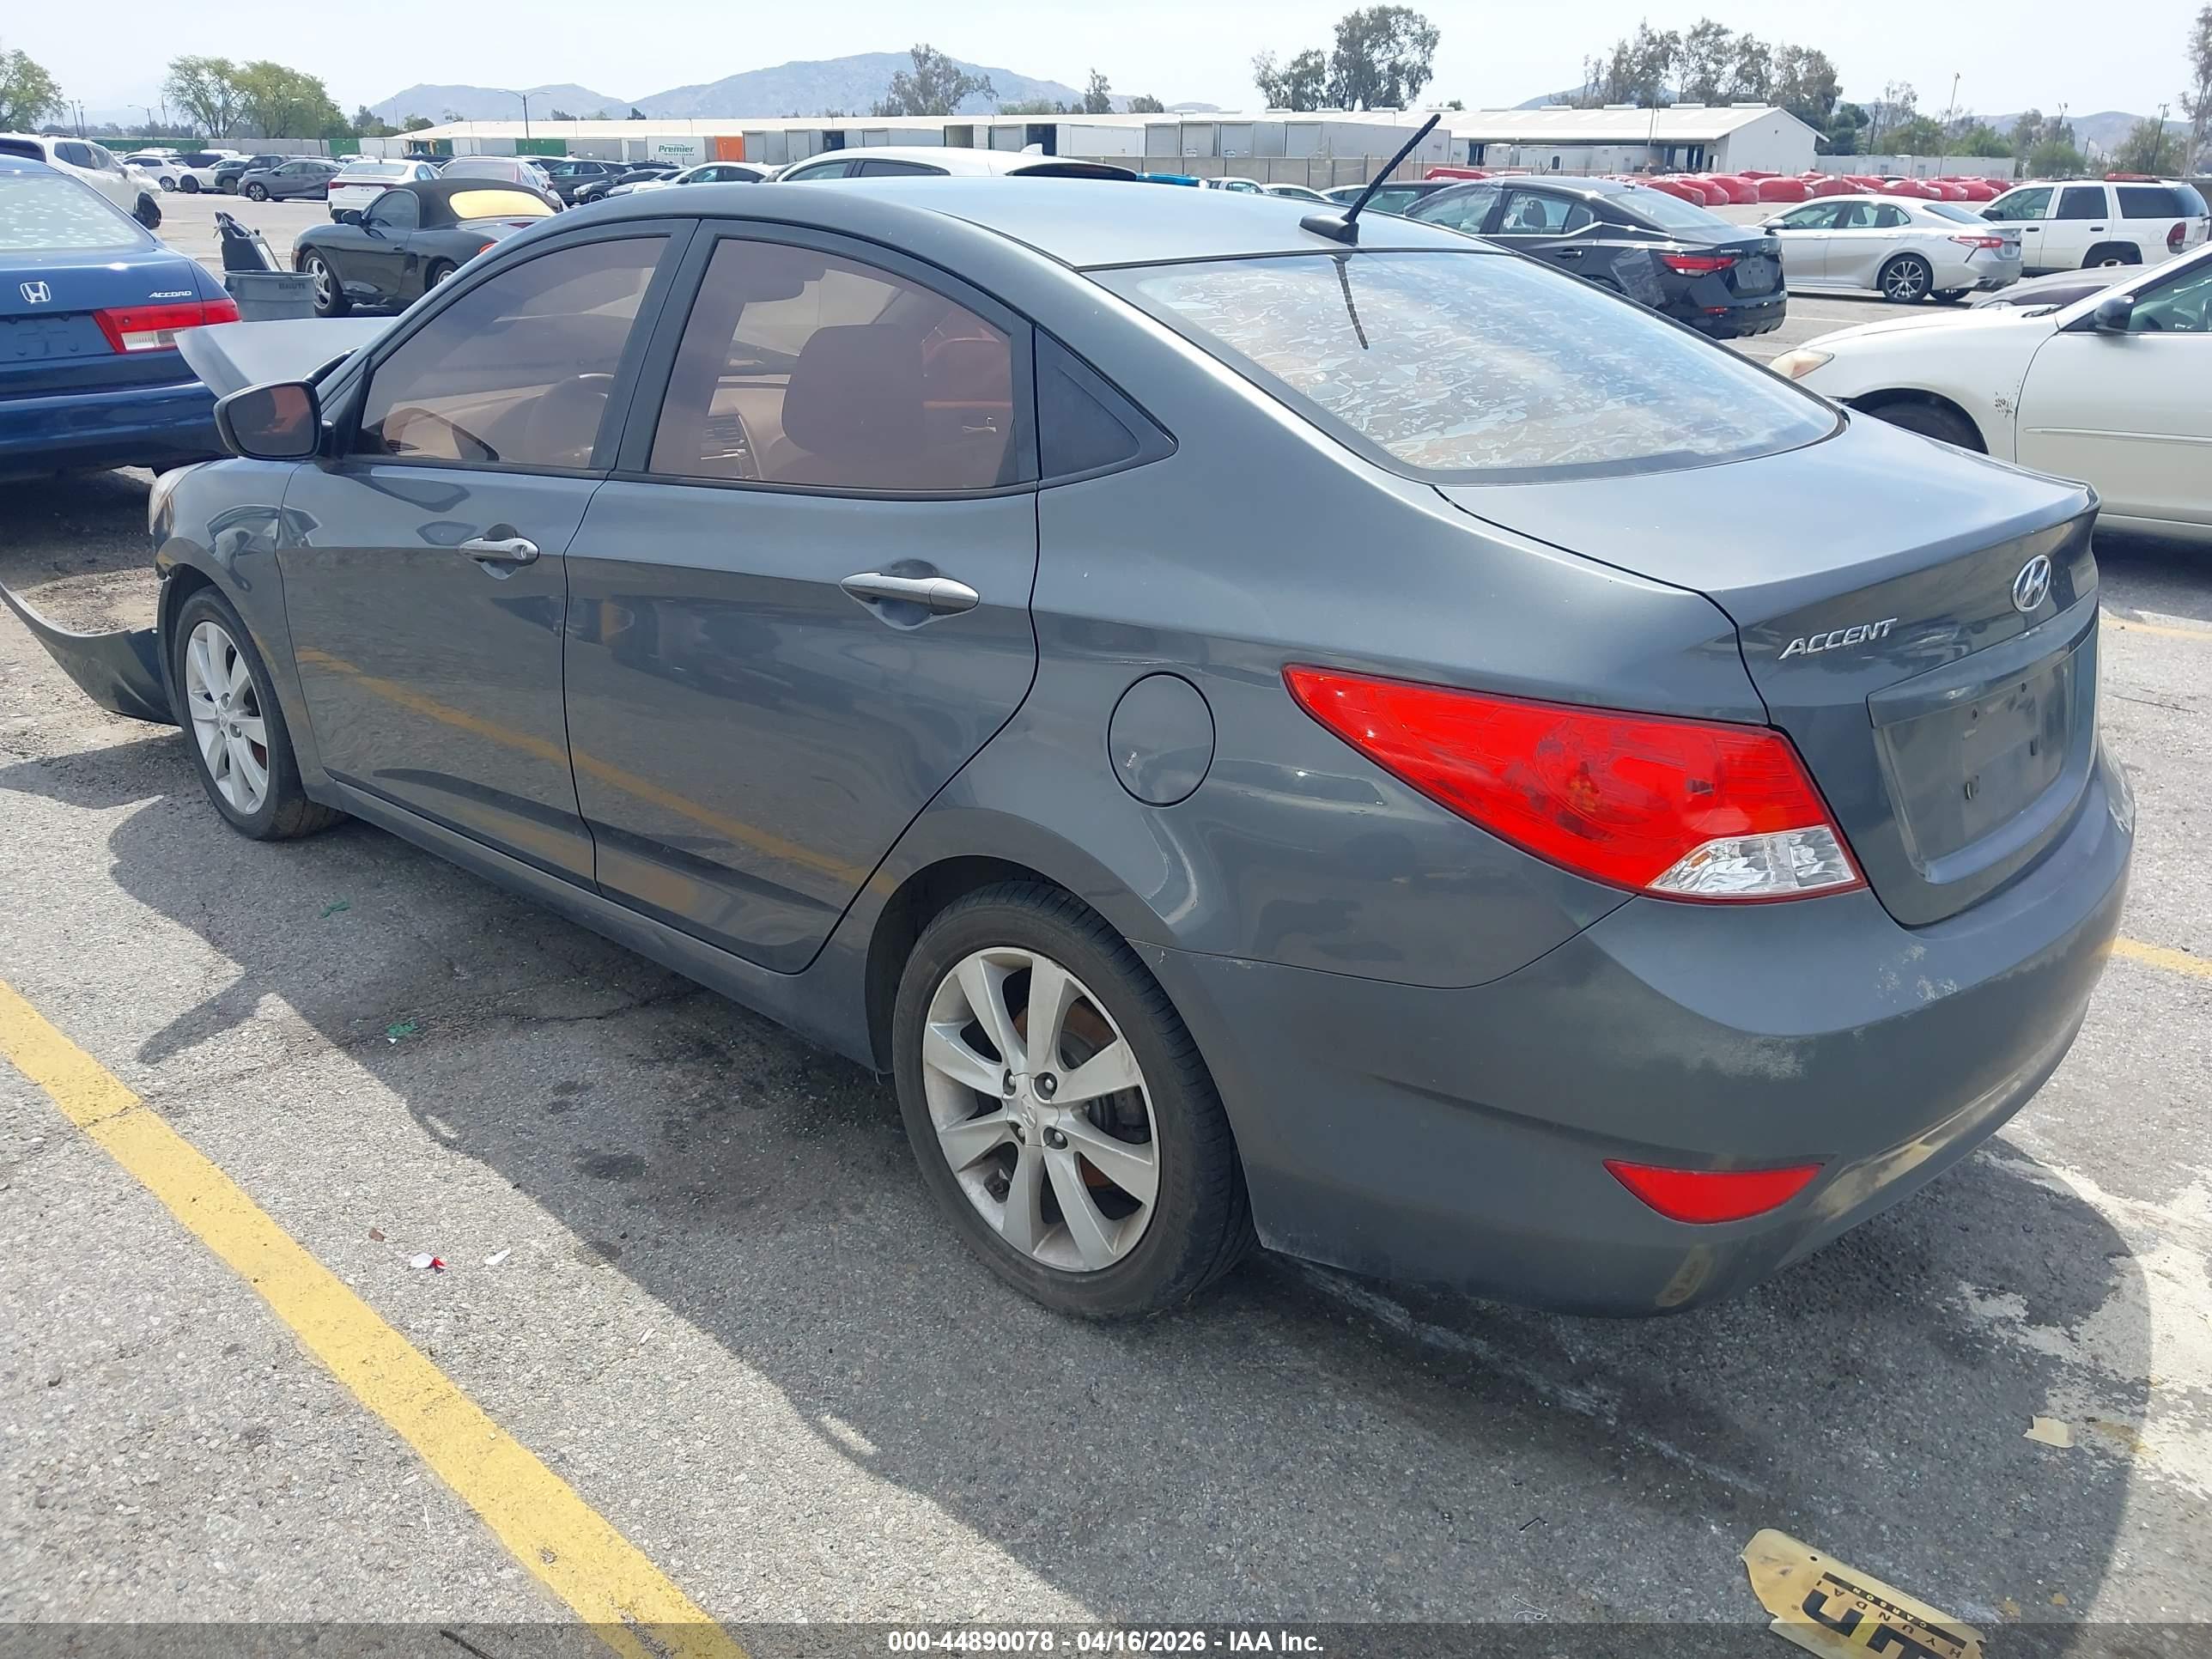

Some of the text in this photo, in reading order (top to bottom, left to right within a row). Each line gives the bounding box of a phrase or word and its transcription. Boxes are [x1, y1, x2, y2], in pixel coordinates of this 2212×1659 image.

[1778, 617, 1898, 659] ACCENT
[1815, 1580, 1961, 1658] HYUNDAI
[1852, 1588, 1927, 1628] CARSON
